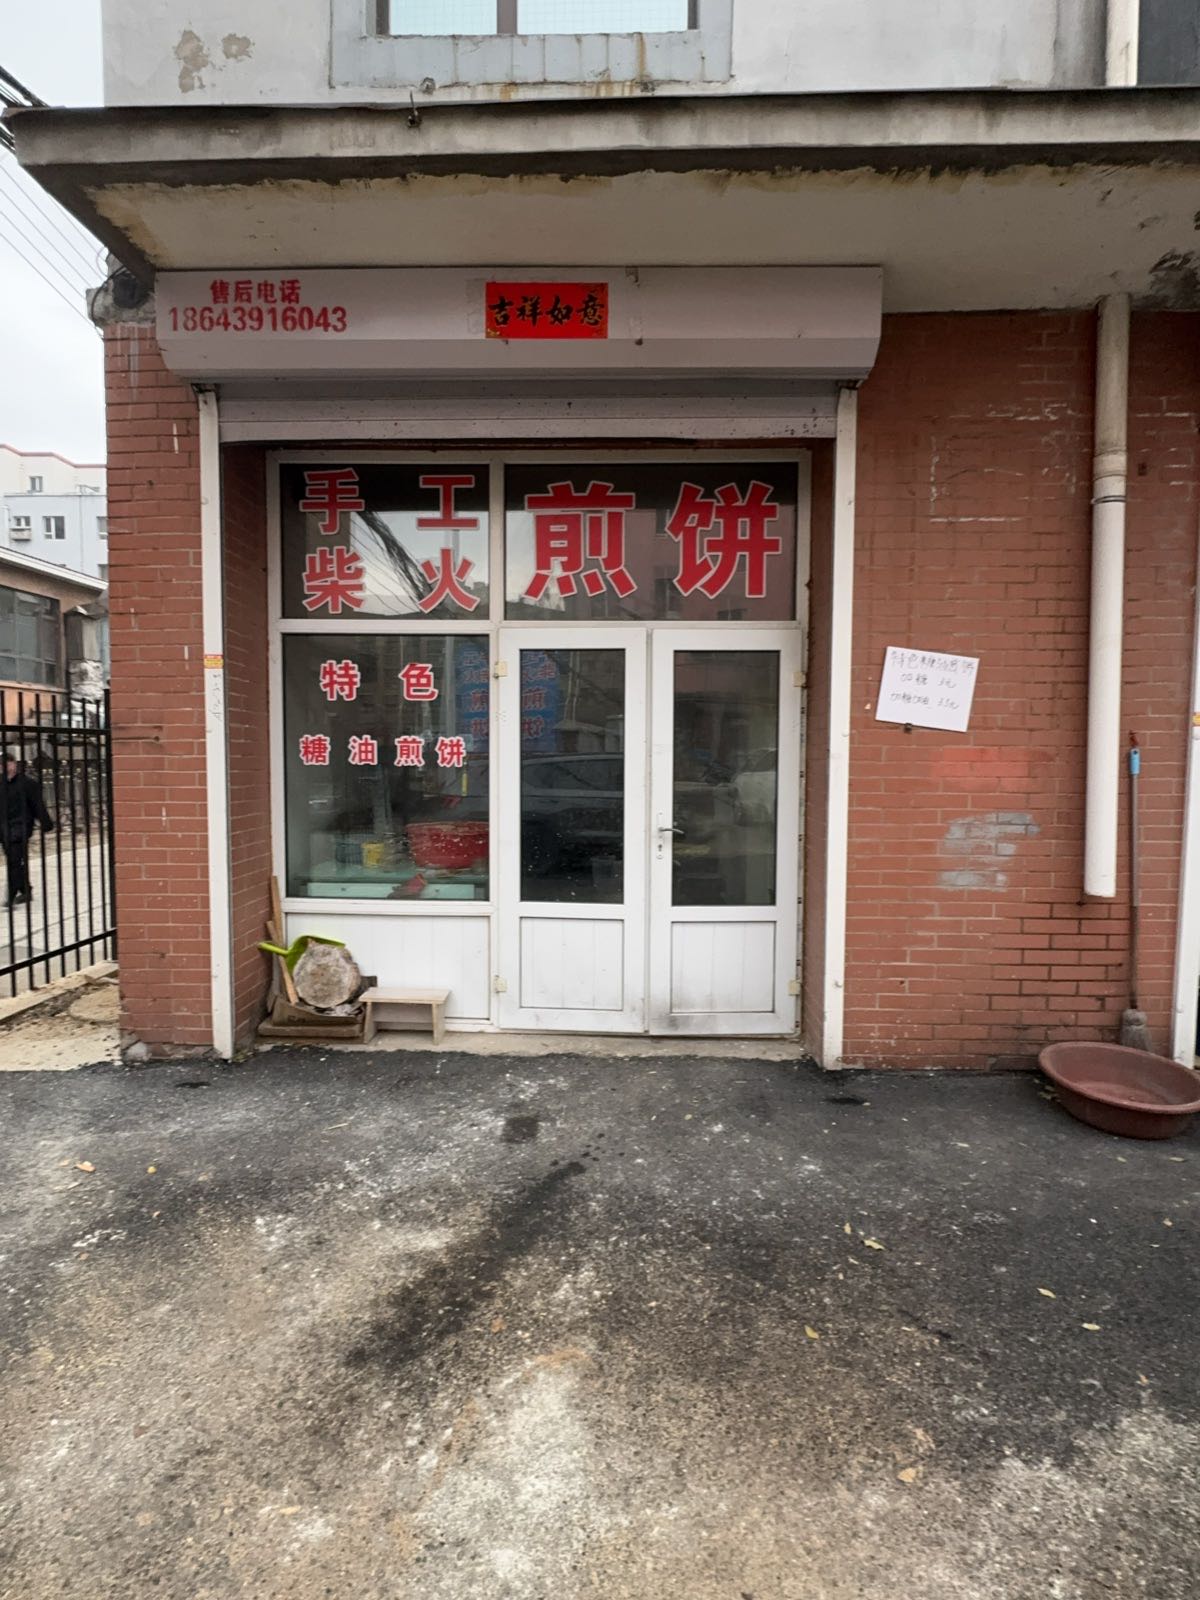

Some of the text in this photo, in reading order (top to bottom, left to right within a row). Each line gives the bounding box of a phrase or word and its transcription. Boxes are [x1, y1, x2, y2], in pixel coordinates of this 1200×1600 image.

[210, 279, 301, 305] 售后电话
[487, 294, 605, 327] 吉祥如意
[168, 305, 348, 333] 18643916043
[300, 468, 480, 535] 手工
[523, 480, 783, 600] 煎饼
[301, 545, 481, 615] 柴火
[319, 660, 438, 701] 特色
[299, 735, 466, 767] 糖油煎饼
